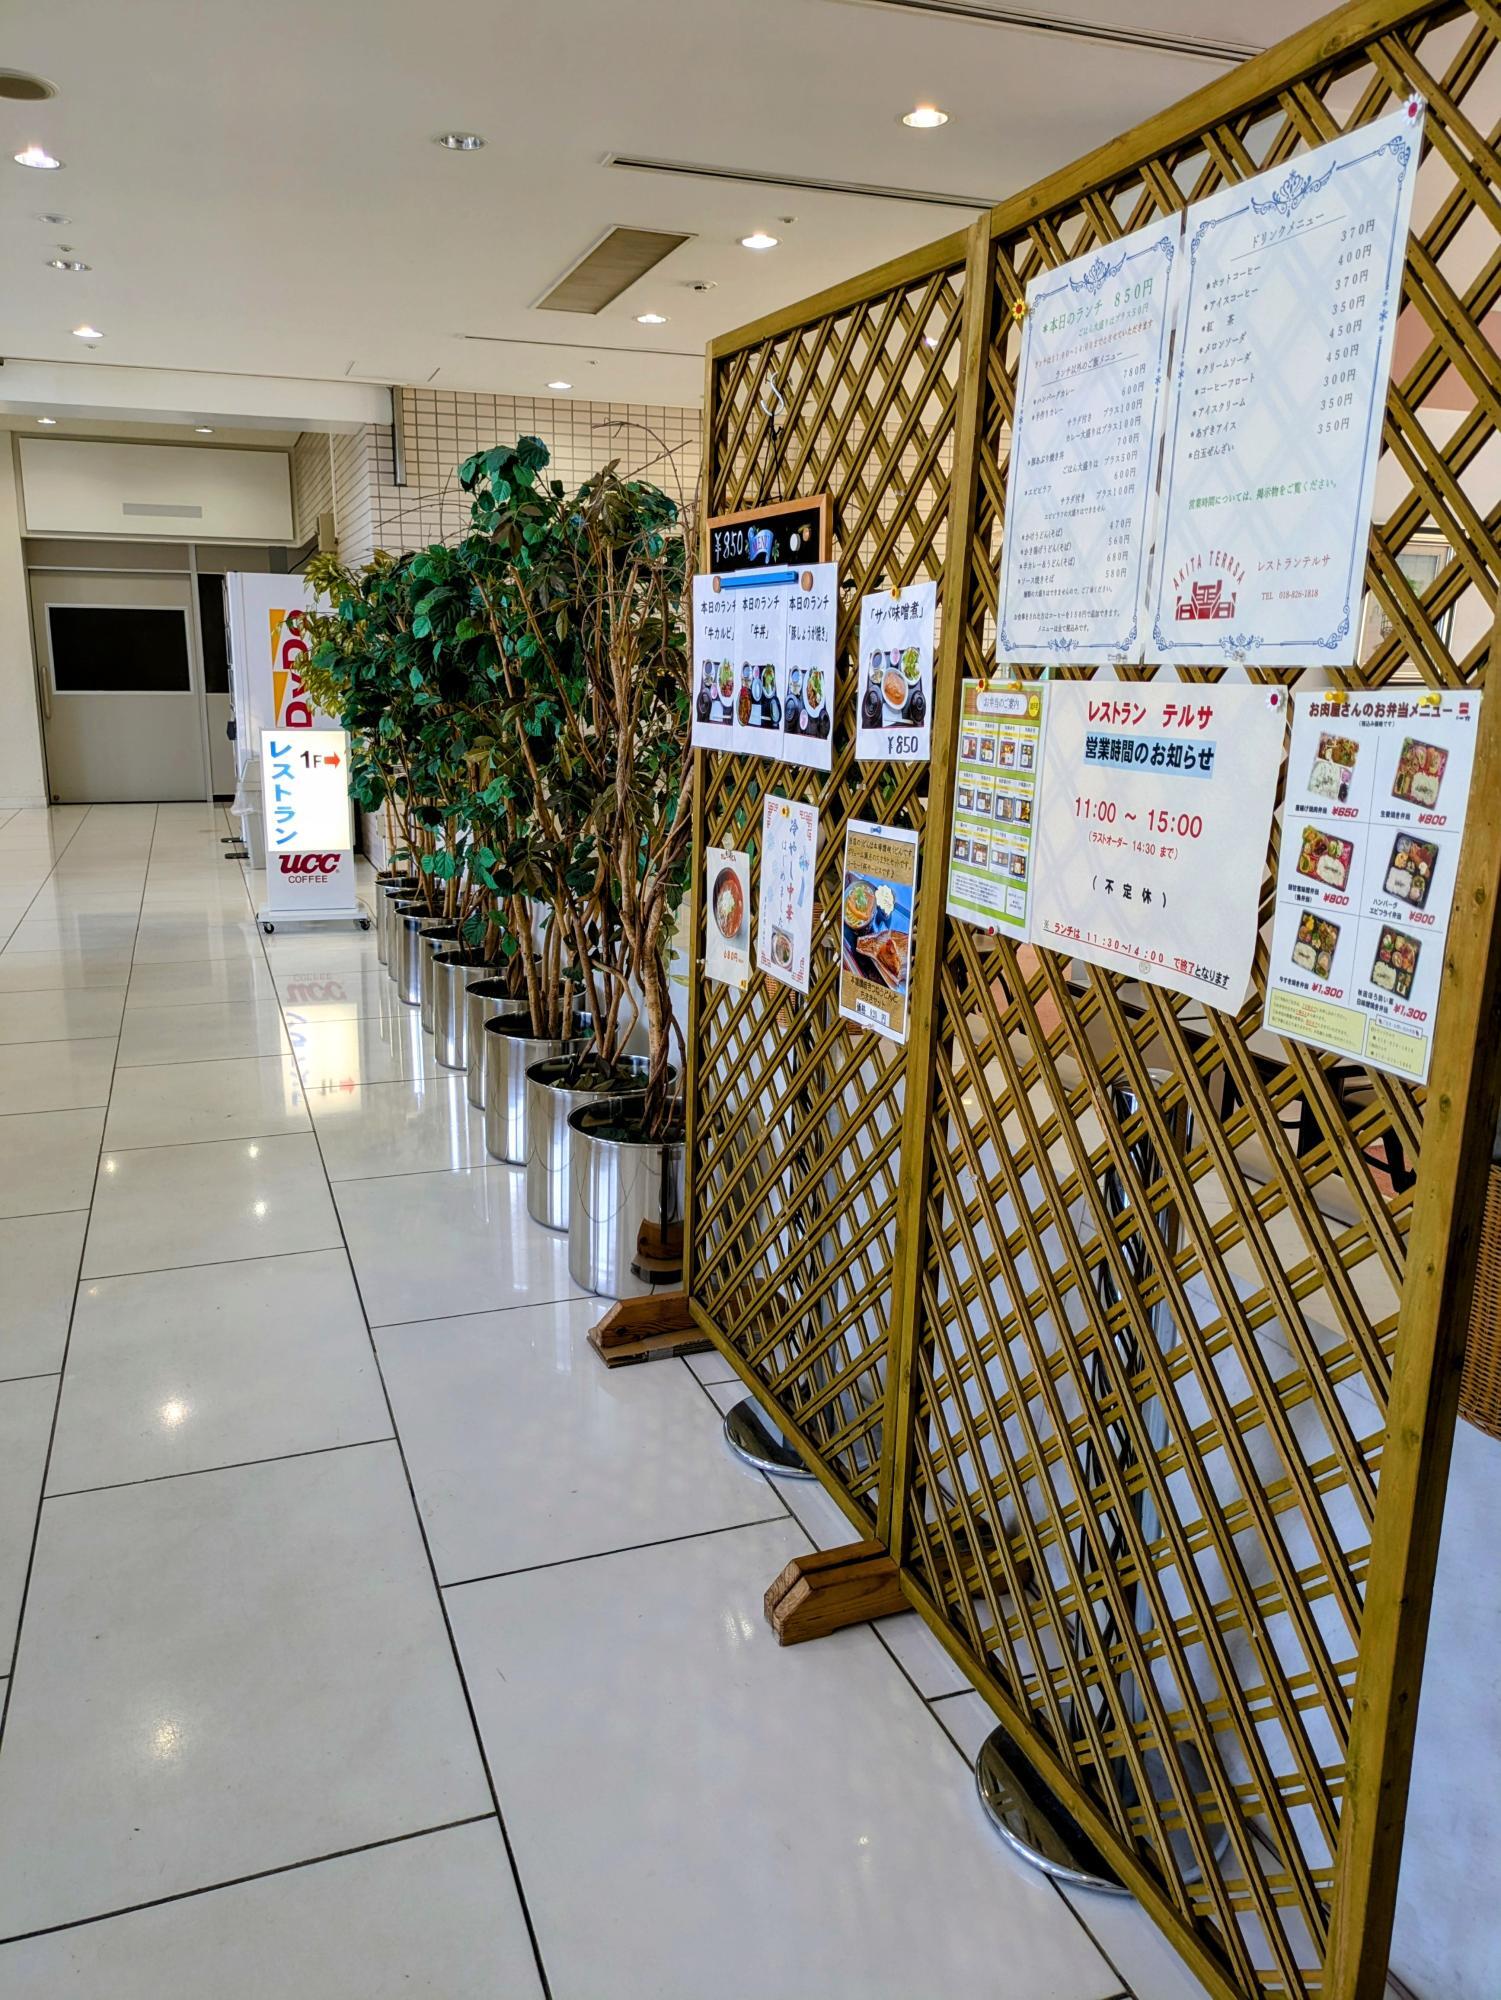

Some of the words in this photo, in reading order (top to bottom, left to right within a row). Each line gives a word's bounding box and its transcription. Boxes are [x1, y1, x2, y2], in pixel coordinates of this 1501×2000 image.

[1252, 213, 1325, 249] ドリンクメニュー
[1340, 218, 1376, 243] 370円
[1337, 243, 1372, 266] 400円
[1334, 269, 1369, 291] 370円
[1113, 277, 1154, 308] 850円
[1331, 294, 1366, 315] 350円
[1328, 319, 1362, 339] 450円
[1326, 343, 1360, 363] 450円
[1322, 368, 1357, 388] 300円
[1319, 392, 1354, 411] 350円
[1317, 417, 1350, 435] 350円
[1172, 553, 1203, 591] AKITA
[1257, 553, 1331, 572] レストランテルサ
[742, 595, 780, 612] 本日のランチ
[789, 594, 830, 611] 本日のランチ
[1261, 591, 1274, 600] TEL
[870, 602, 924, 625] 「サバ味噌煮」
[750, 623, 769, 641] 「牛丼」
[1087, 700, 1147, 726] レストラン
[1162, 703, 1214, 730] テルサ
[887, 735, 919, 754] ¥850
[1085, 735, 1215, 771] 営業時間のお知らせ
[299, 750, 323, 769] 1F
[270, 740, 298, 846] レストラン
[1075, 796, 1117, 824] 11:00
[1148, 808, 1203, 839] 15:00
[1331, 805, 1359, 818] ¥650
[1132, 840, 1156, 856] 14:30
[288, 874, 329, 884] COFFEE
[1054, 922, 1081, 940] ランチは
[1173, 956, 1231, 988] で終了となります
[1311, 982, 1344, 999] ¥1,300
[1393, 1003, 1428, 1022] ¥1,300
